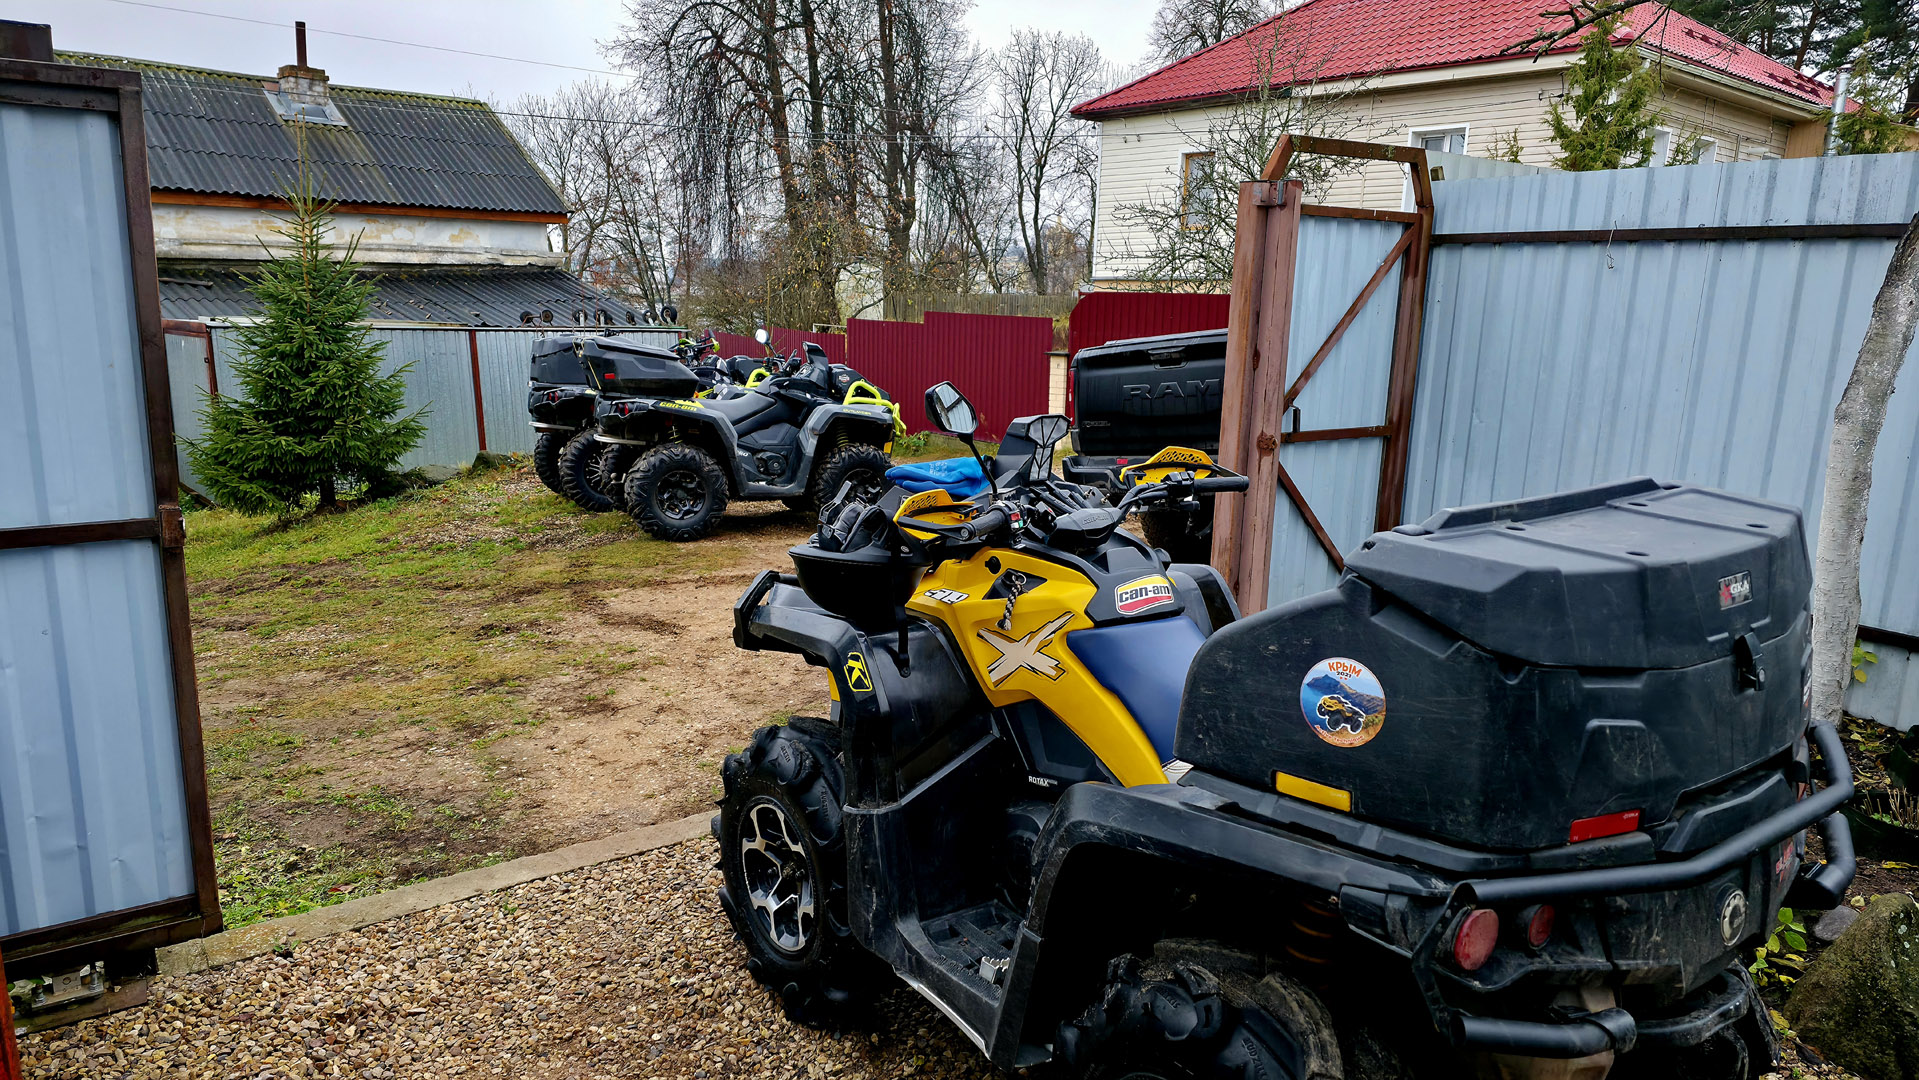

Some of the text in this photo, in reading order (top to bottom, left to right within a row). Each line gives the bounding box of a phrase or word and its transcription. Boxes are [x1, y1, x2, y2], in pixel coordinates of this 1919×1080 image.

[1122, 379, 1220, 400] RAM
[1118, 585, 1171, 603] can-am
[1328, 661, 1362, 677] КРЫМ
[1028, 775, 1050, 787] ROTAX
